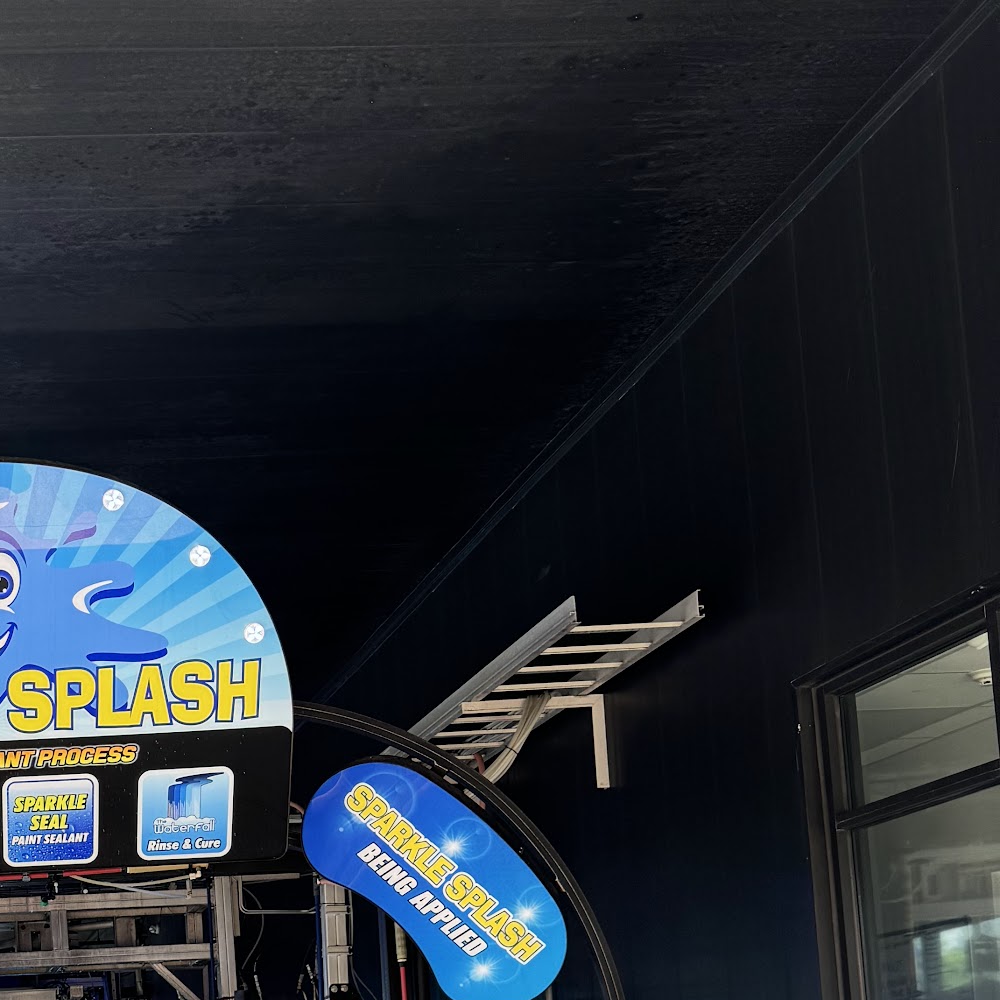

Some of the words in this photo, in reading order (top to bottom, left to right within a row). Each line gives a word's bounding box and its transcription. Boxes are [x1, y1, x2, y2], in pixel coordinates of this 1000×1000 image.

[6, 658, 261, 734] SPLASH
[36, 744, 139, 768] PROCESS
[13, 793, 88, 813] SPARKLE
[29, 814, 69, 831] SEAL
[12, 834, 43, 846] PAINT
[43, 832, 89, 845] SEALANT
[147, 839, 179, 852] Rinse
[181, 838, 192, 850] &
[194, 836, 221, 849] Cure
[344, 781, 459, 889] SPARKLE
[443, 871, 547, 966] SPLASH
[355, 841, 419, 897] BEING
[408, 890, 489, 958] APPLIED
